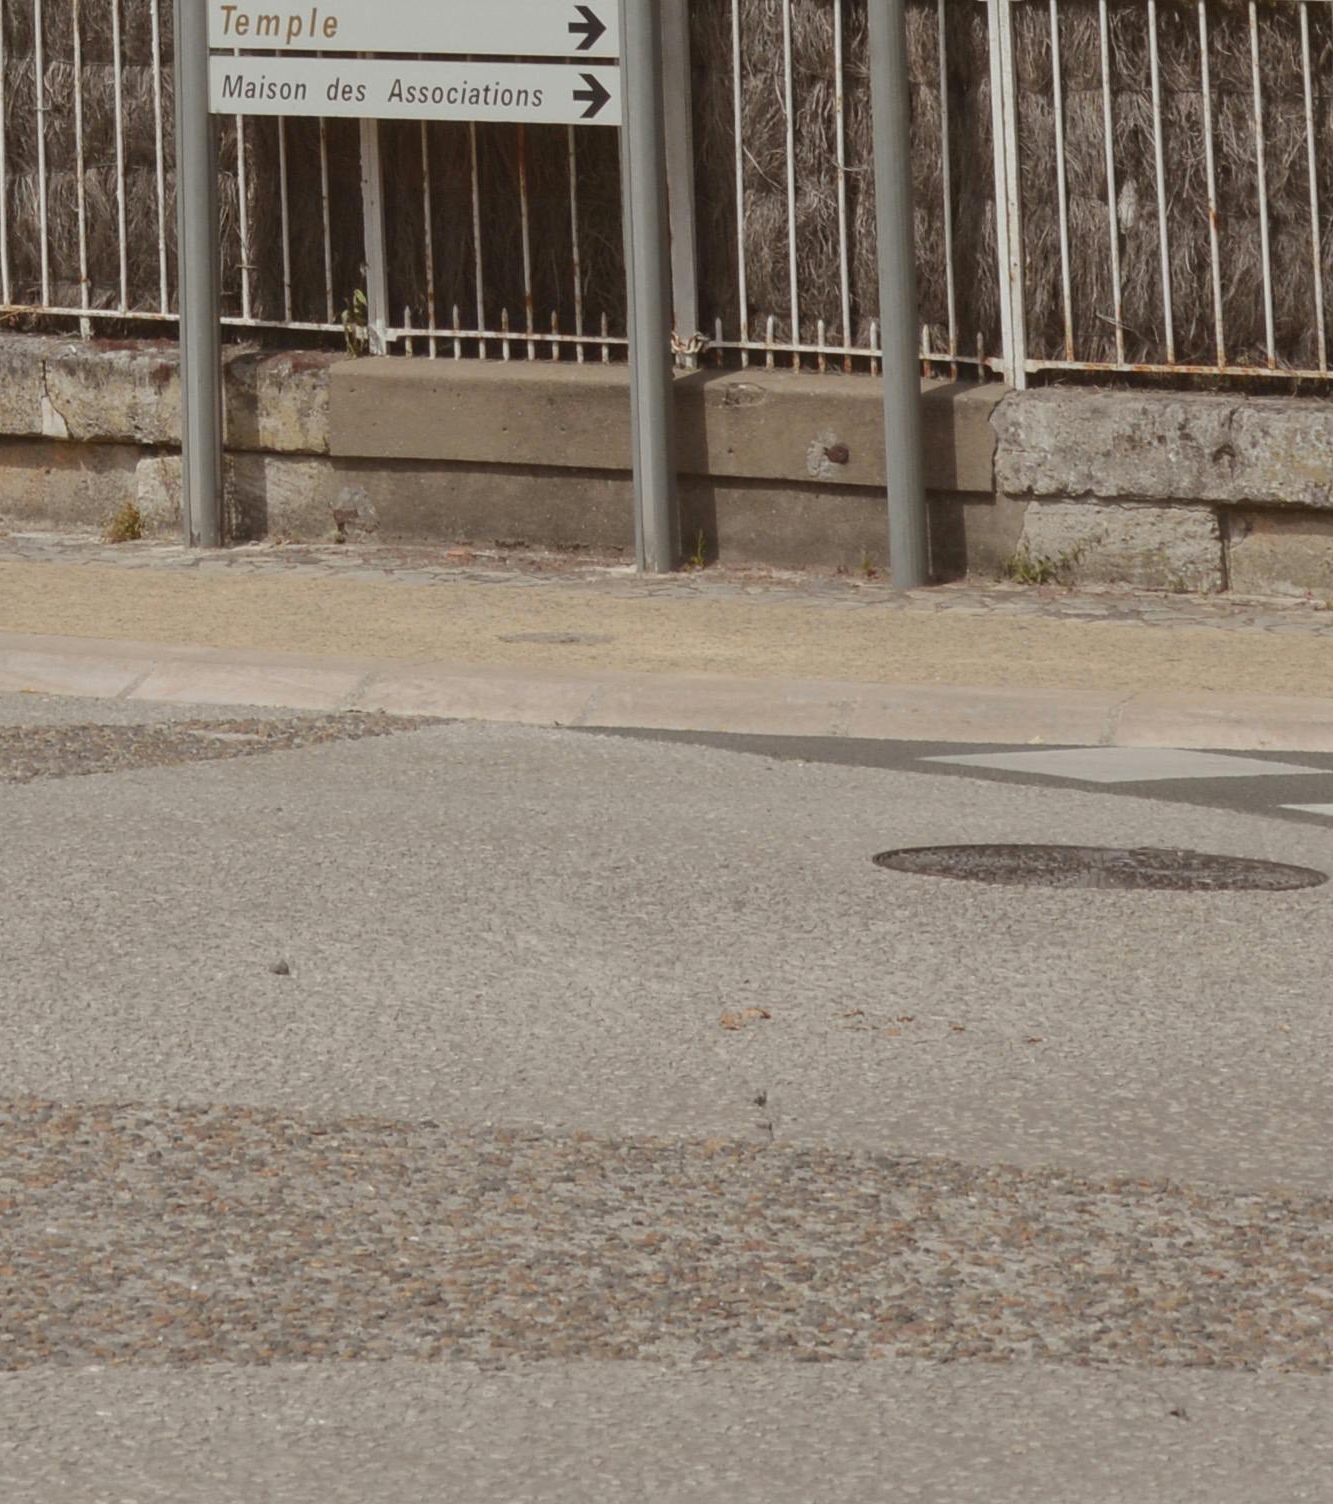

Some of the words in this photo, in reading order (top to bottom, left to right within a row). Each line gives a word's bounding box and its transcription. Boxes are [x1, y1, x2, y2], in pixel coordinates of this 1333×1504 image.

[221, 6, 337, 45] Temple
[223, 75, 306, 100] Maison
[327, 78, 365, 101] des
[388, 79, 542, 107] Associations
